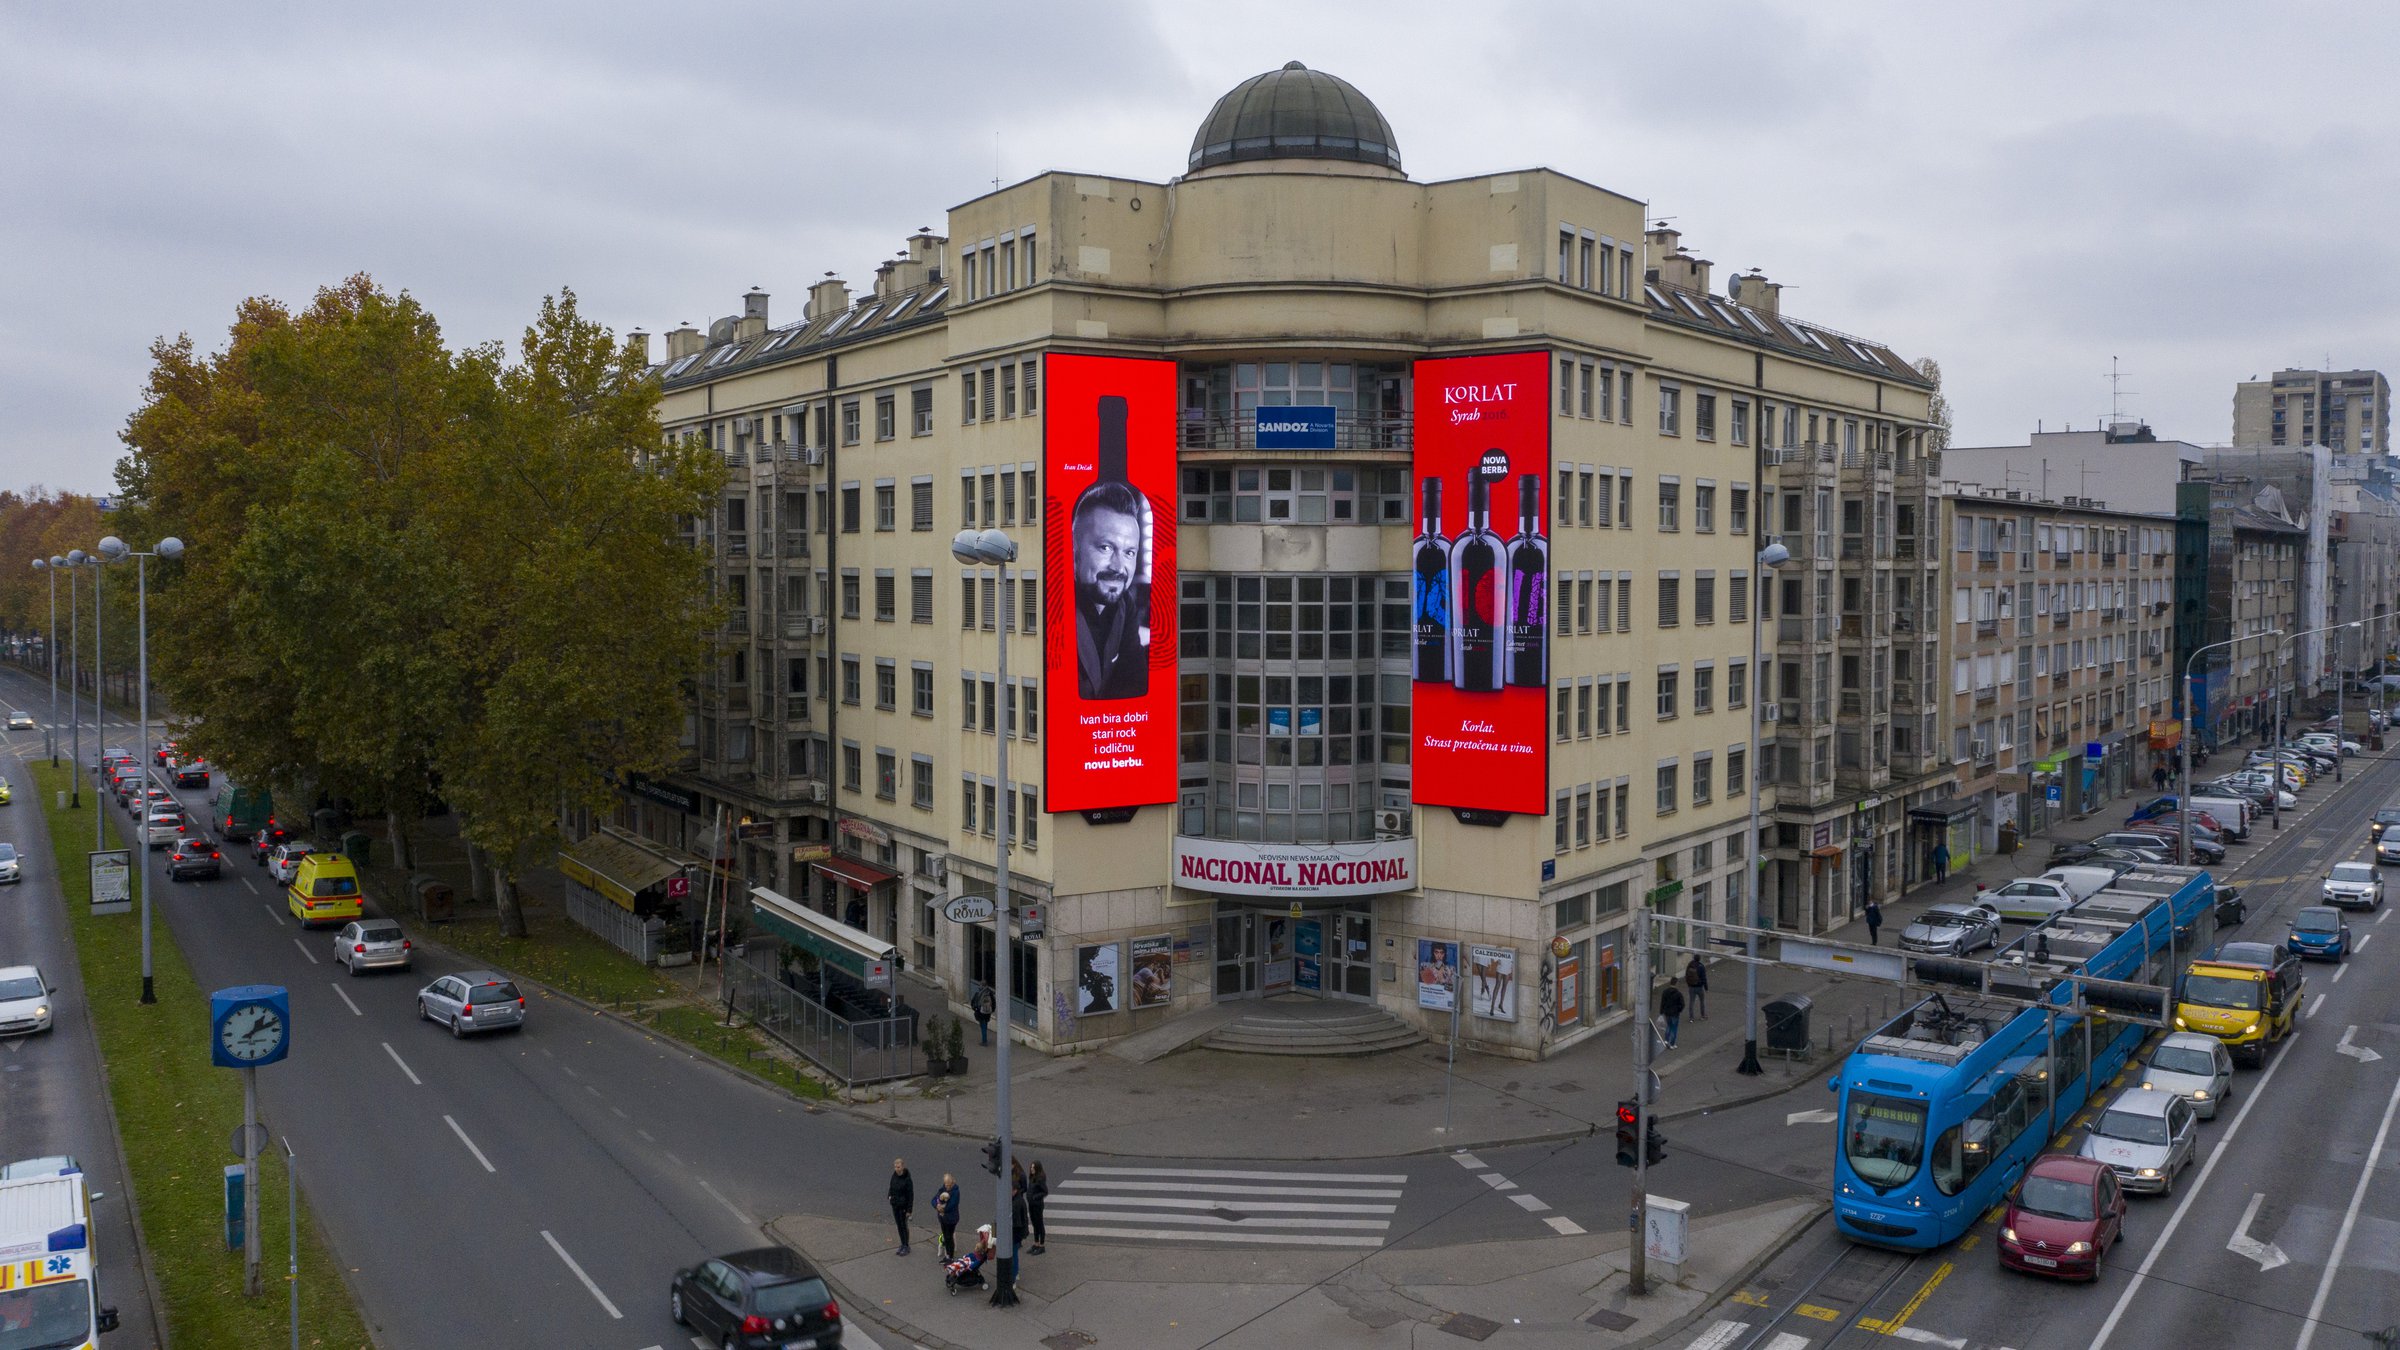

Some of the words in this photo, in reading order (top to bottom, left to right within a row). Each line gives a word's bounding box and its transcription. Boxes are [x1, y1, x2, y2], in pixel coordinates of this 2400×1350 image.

[1444, 383, 1517, 404] KORLAT
[1450, 408, 1481, 425] Syrah
[1258, 422, 1309, 433] SANDOZ
[1483, 456, 1506, 465] NOVA
[1481, 465, 1508, 474] BERBA
[1080, 715, 1101, 725] Ivan
[1102, 713, 1121, 724] bira
[1123, 711, 1148, 722] dobri
[1092, 728, 1114, 739] stari
[1116, 727, 1137, 738] rock
[1461, 720, 1495, 734] Korlat.
[1094, 744, 1097, 754] i
[1099, 742, 1135, 754] odličnu
[1424, 735, 1452, 748] Strast
[1452, 739, 1498, 754] pretočena
[1500, 743, 1507, 752] u
[1510, 742, 1534, 754] vino.
[1084, 761, 1110, 770] novu
[1112, 757, 1144, 768] berbu.
[2050, 788, 2057, 798] P
[1290, 854, 1309, 862] NEWS
[1181, 855, 1292, 886] NACIONAL
[1298, 857, 1408, 886] NACIONAL
[953, 907, 987, 920] ROYAL
[1024, 933, 1042, 941] ROYAL
[1475, 949, 1512, 959] CALZEDONIA
[1856, 1103, 1867, 1115] 12
